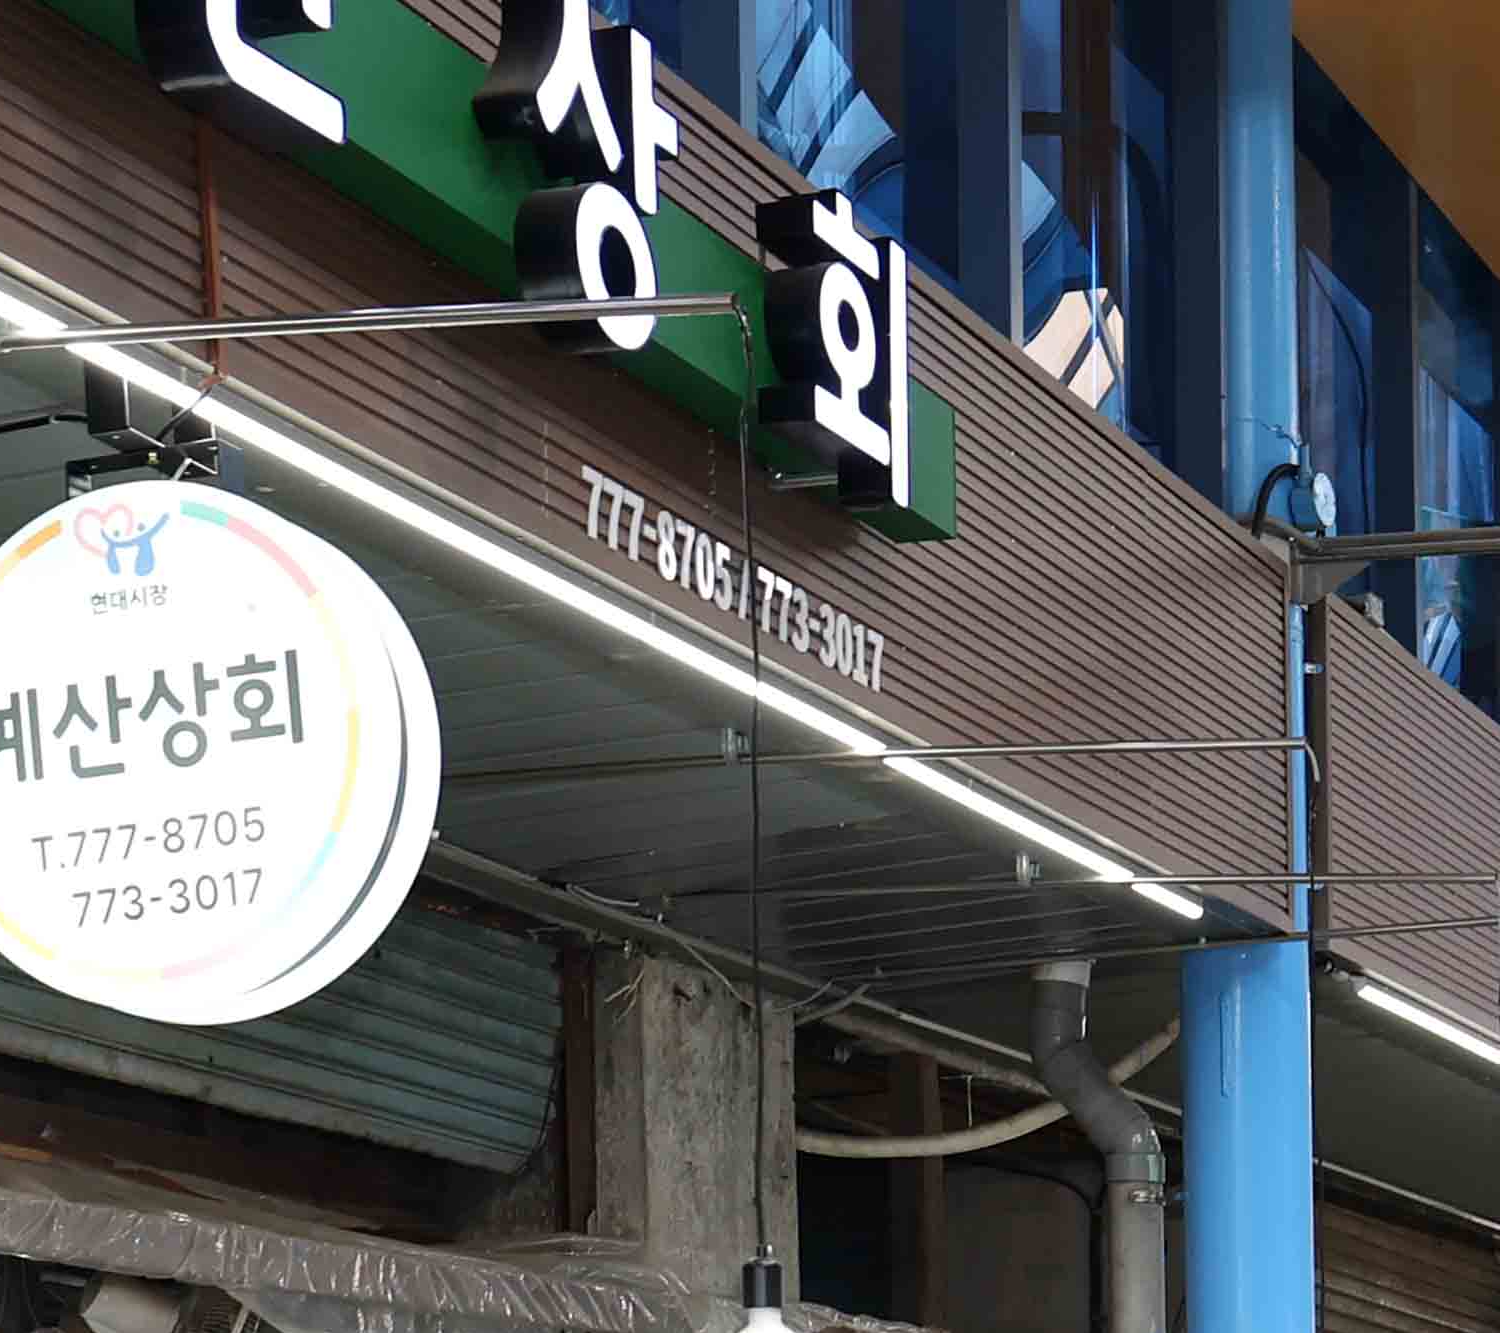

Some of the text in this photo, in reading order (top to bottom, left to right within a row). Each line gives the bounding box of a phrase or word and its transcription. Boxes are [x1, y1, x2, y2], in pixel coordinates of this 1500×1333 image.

[89, 582, 169, 615] 현대시장
[581, 465, 733, 611] 777-8705
[757, 566, 885, 692] 773-3017
[31, 806, 266, 872] T.777-8705
[71, 869, 264, 928] 773-3017
